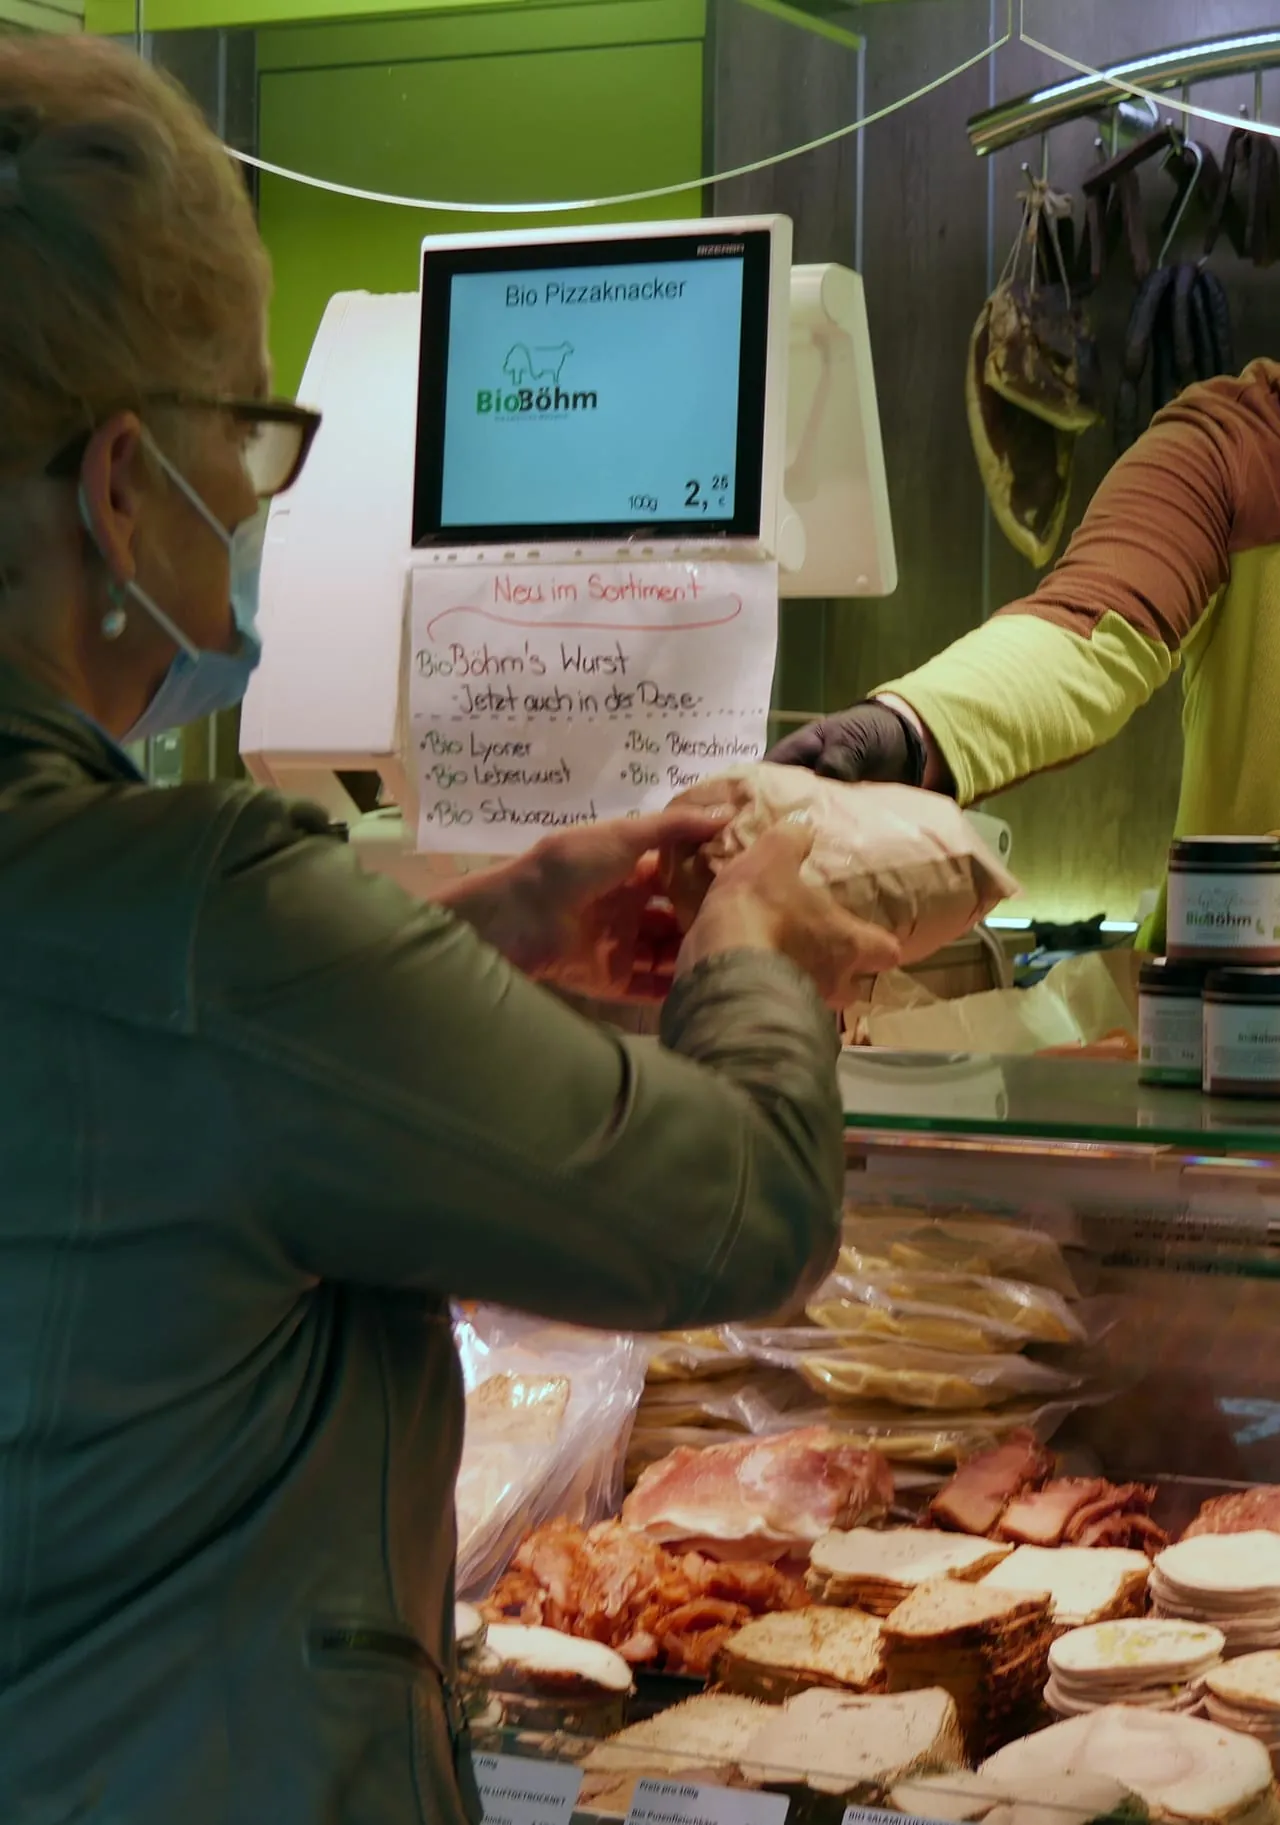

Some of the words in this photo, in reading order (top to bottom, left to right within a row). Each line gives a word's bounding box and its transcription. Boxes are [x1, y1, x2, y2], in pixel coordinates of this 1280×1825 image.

[505, 285, 538, 308] Bio
[544, 277, 688, 306] Pizzaknacker
[476, 387, 598, 414] BioBöhm
[628, 494, 658, 512] 100g
[494, 574, 545, 604] Neu
[552, 576, 577, 601] im
[588, 571, 705, 603] Sortiment
[560, 641, 630, 676] Wurst
[523, 685, 573, 713] auch
[578, 689, 598, 713] in
[604, 684, 636, 712] der
[425, 730, 463, 757] Bio
[470, 732, 532, 764] Lyoner
[627, 730, 661, 755] Bio
[664, 730, 760, 759] Bierschinken
[430, 762, 468, 790] Bio
[473, 757, 572, 787] Leberwurst
[628, 761, 660, 786] Bio
[433, 799, 474, 828] Bio
[479, 797, 599, 827] Schwarzwurst
[639, 1779, 661, 1793] Preis
